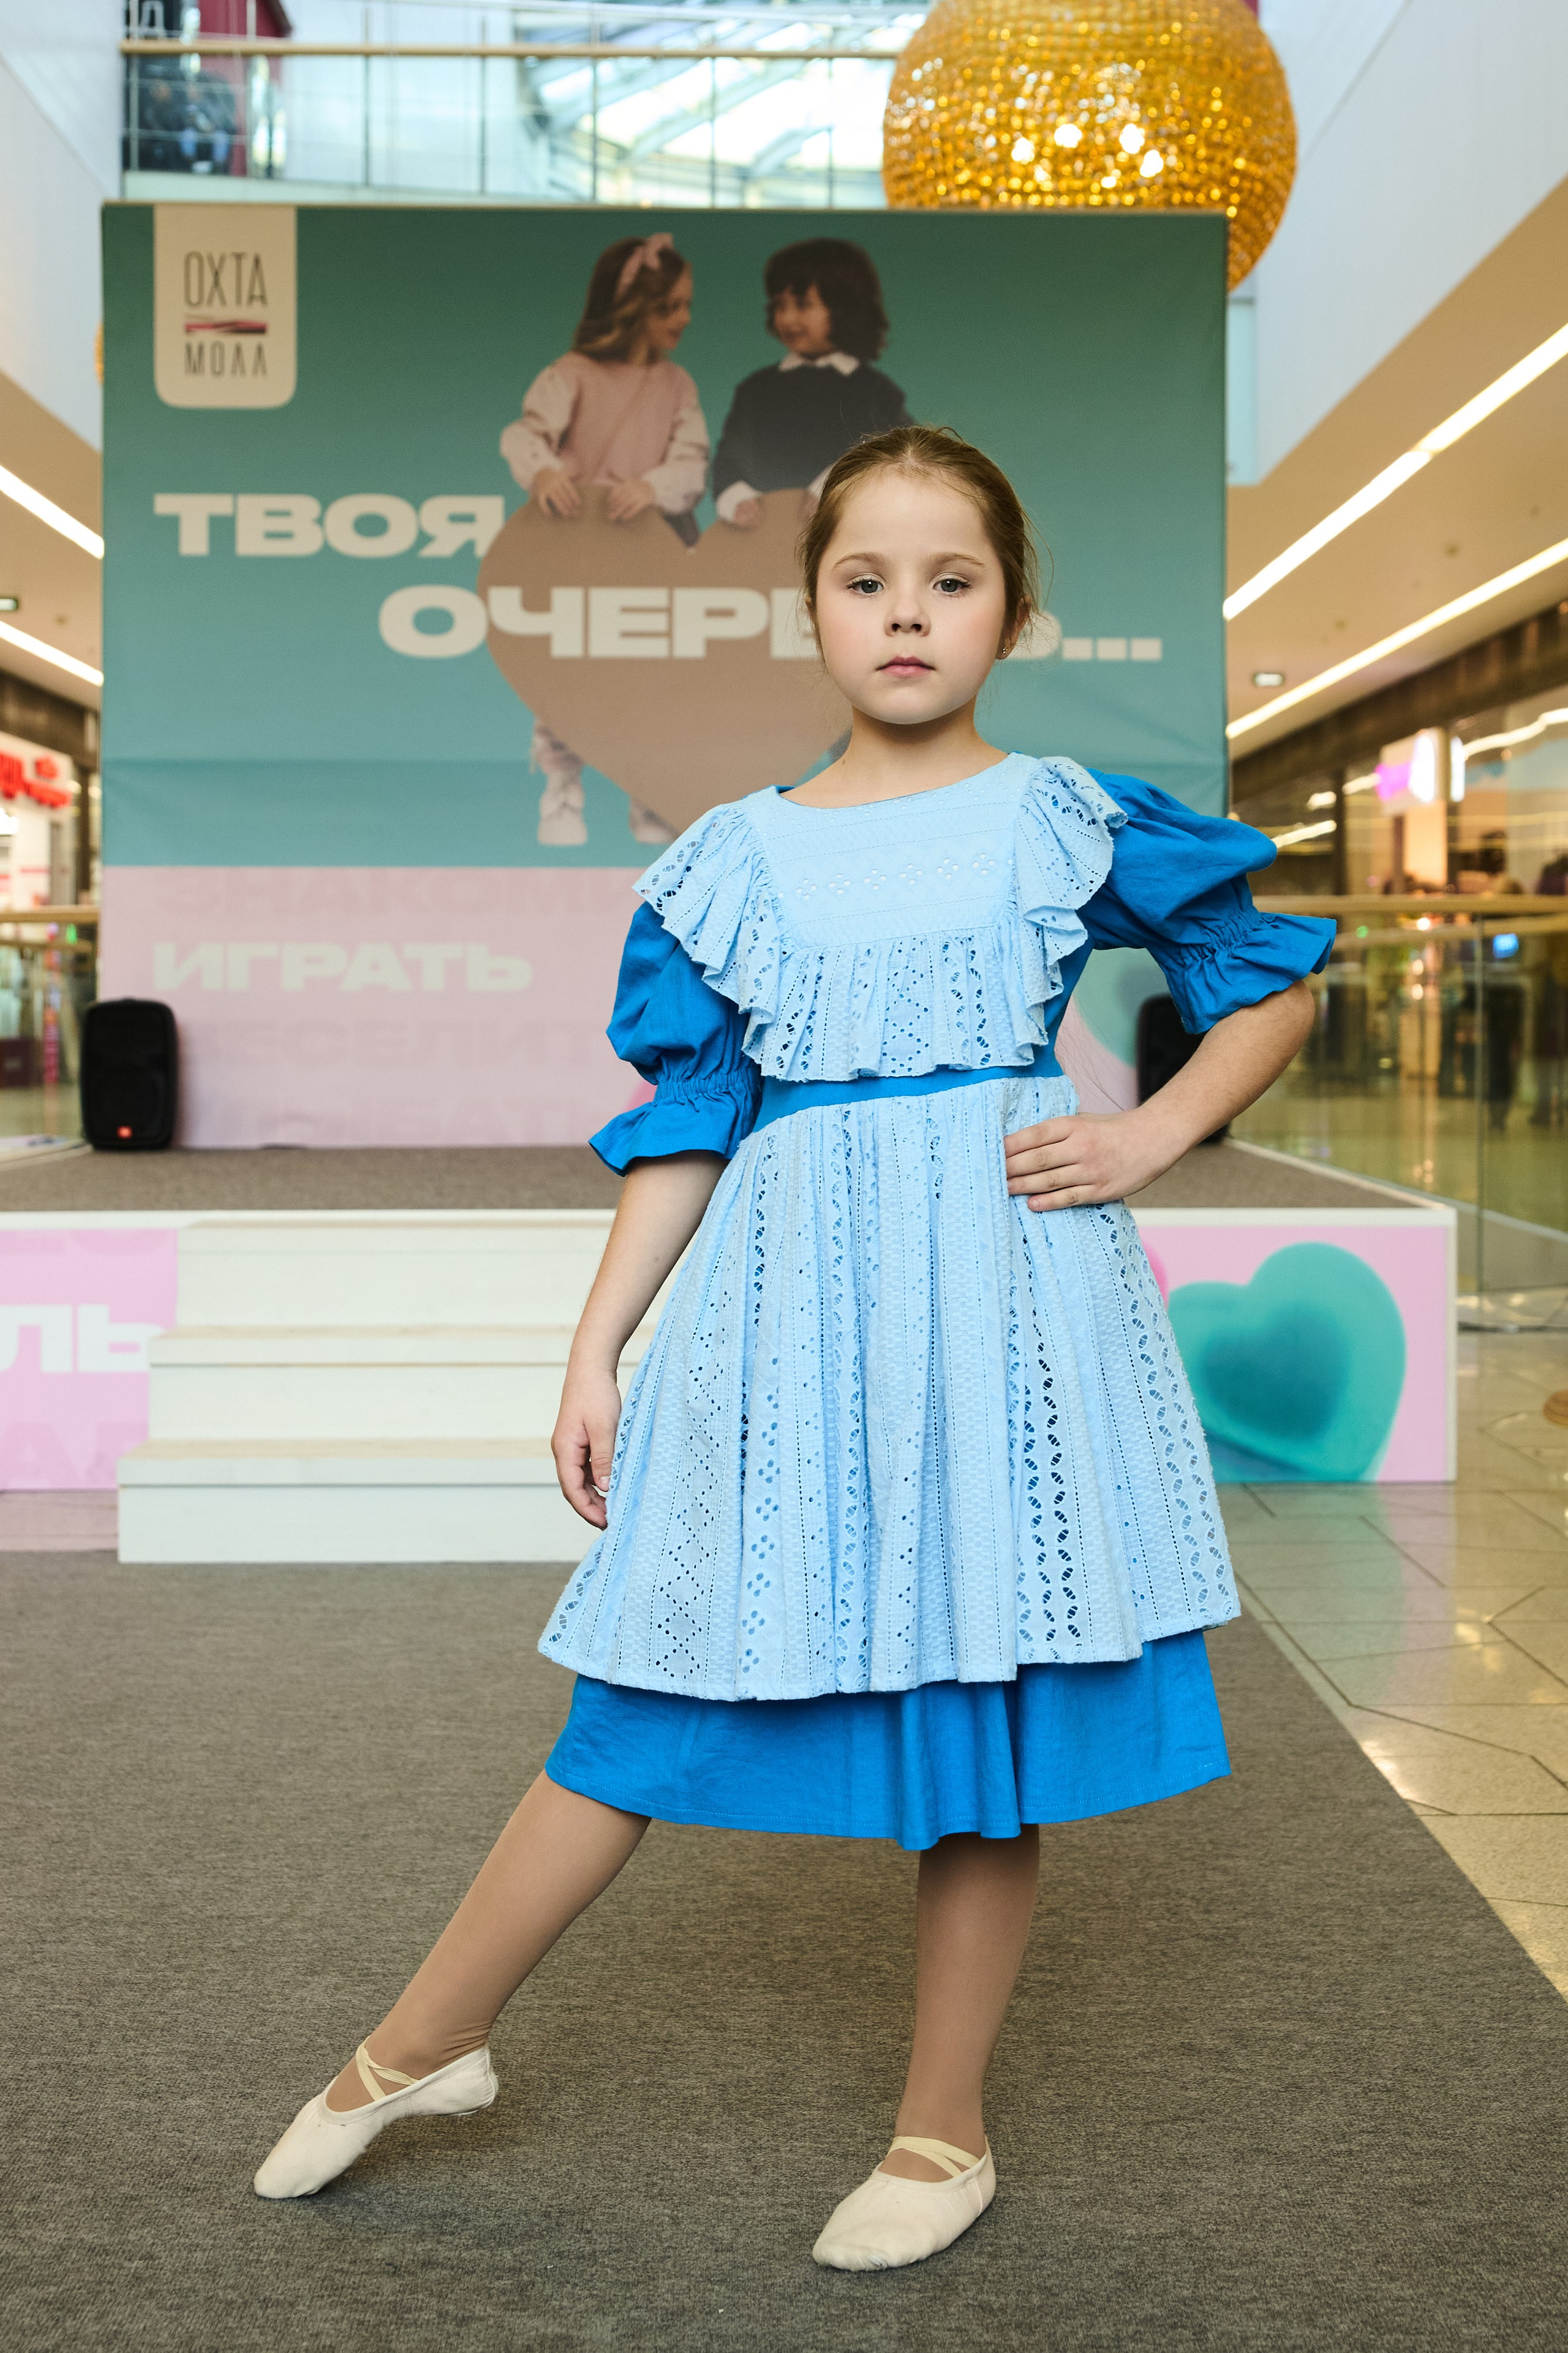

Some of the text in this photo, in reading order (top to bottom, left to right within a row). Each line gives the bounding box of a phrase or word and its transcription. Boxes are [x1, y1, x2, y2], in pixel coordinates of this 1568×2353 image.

[184, 251, 268, 307] ОХТА
[185, 342, 268, 377] МОЛЛ
[153, 493, 505, 557] ТВОЯ
[153, 942, 533, 992] ИГРАТЬ
